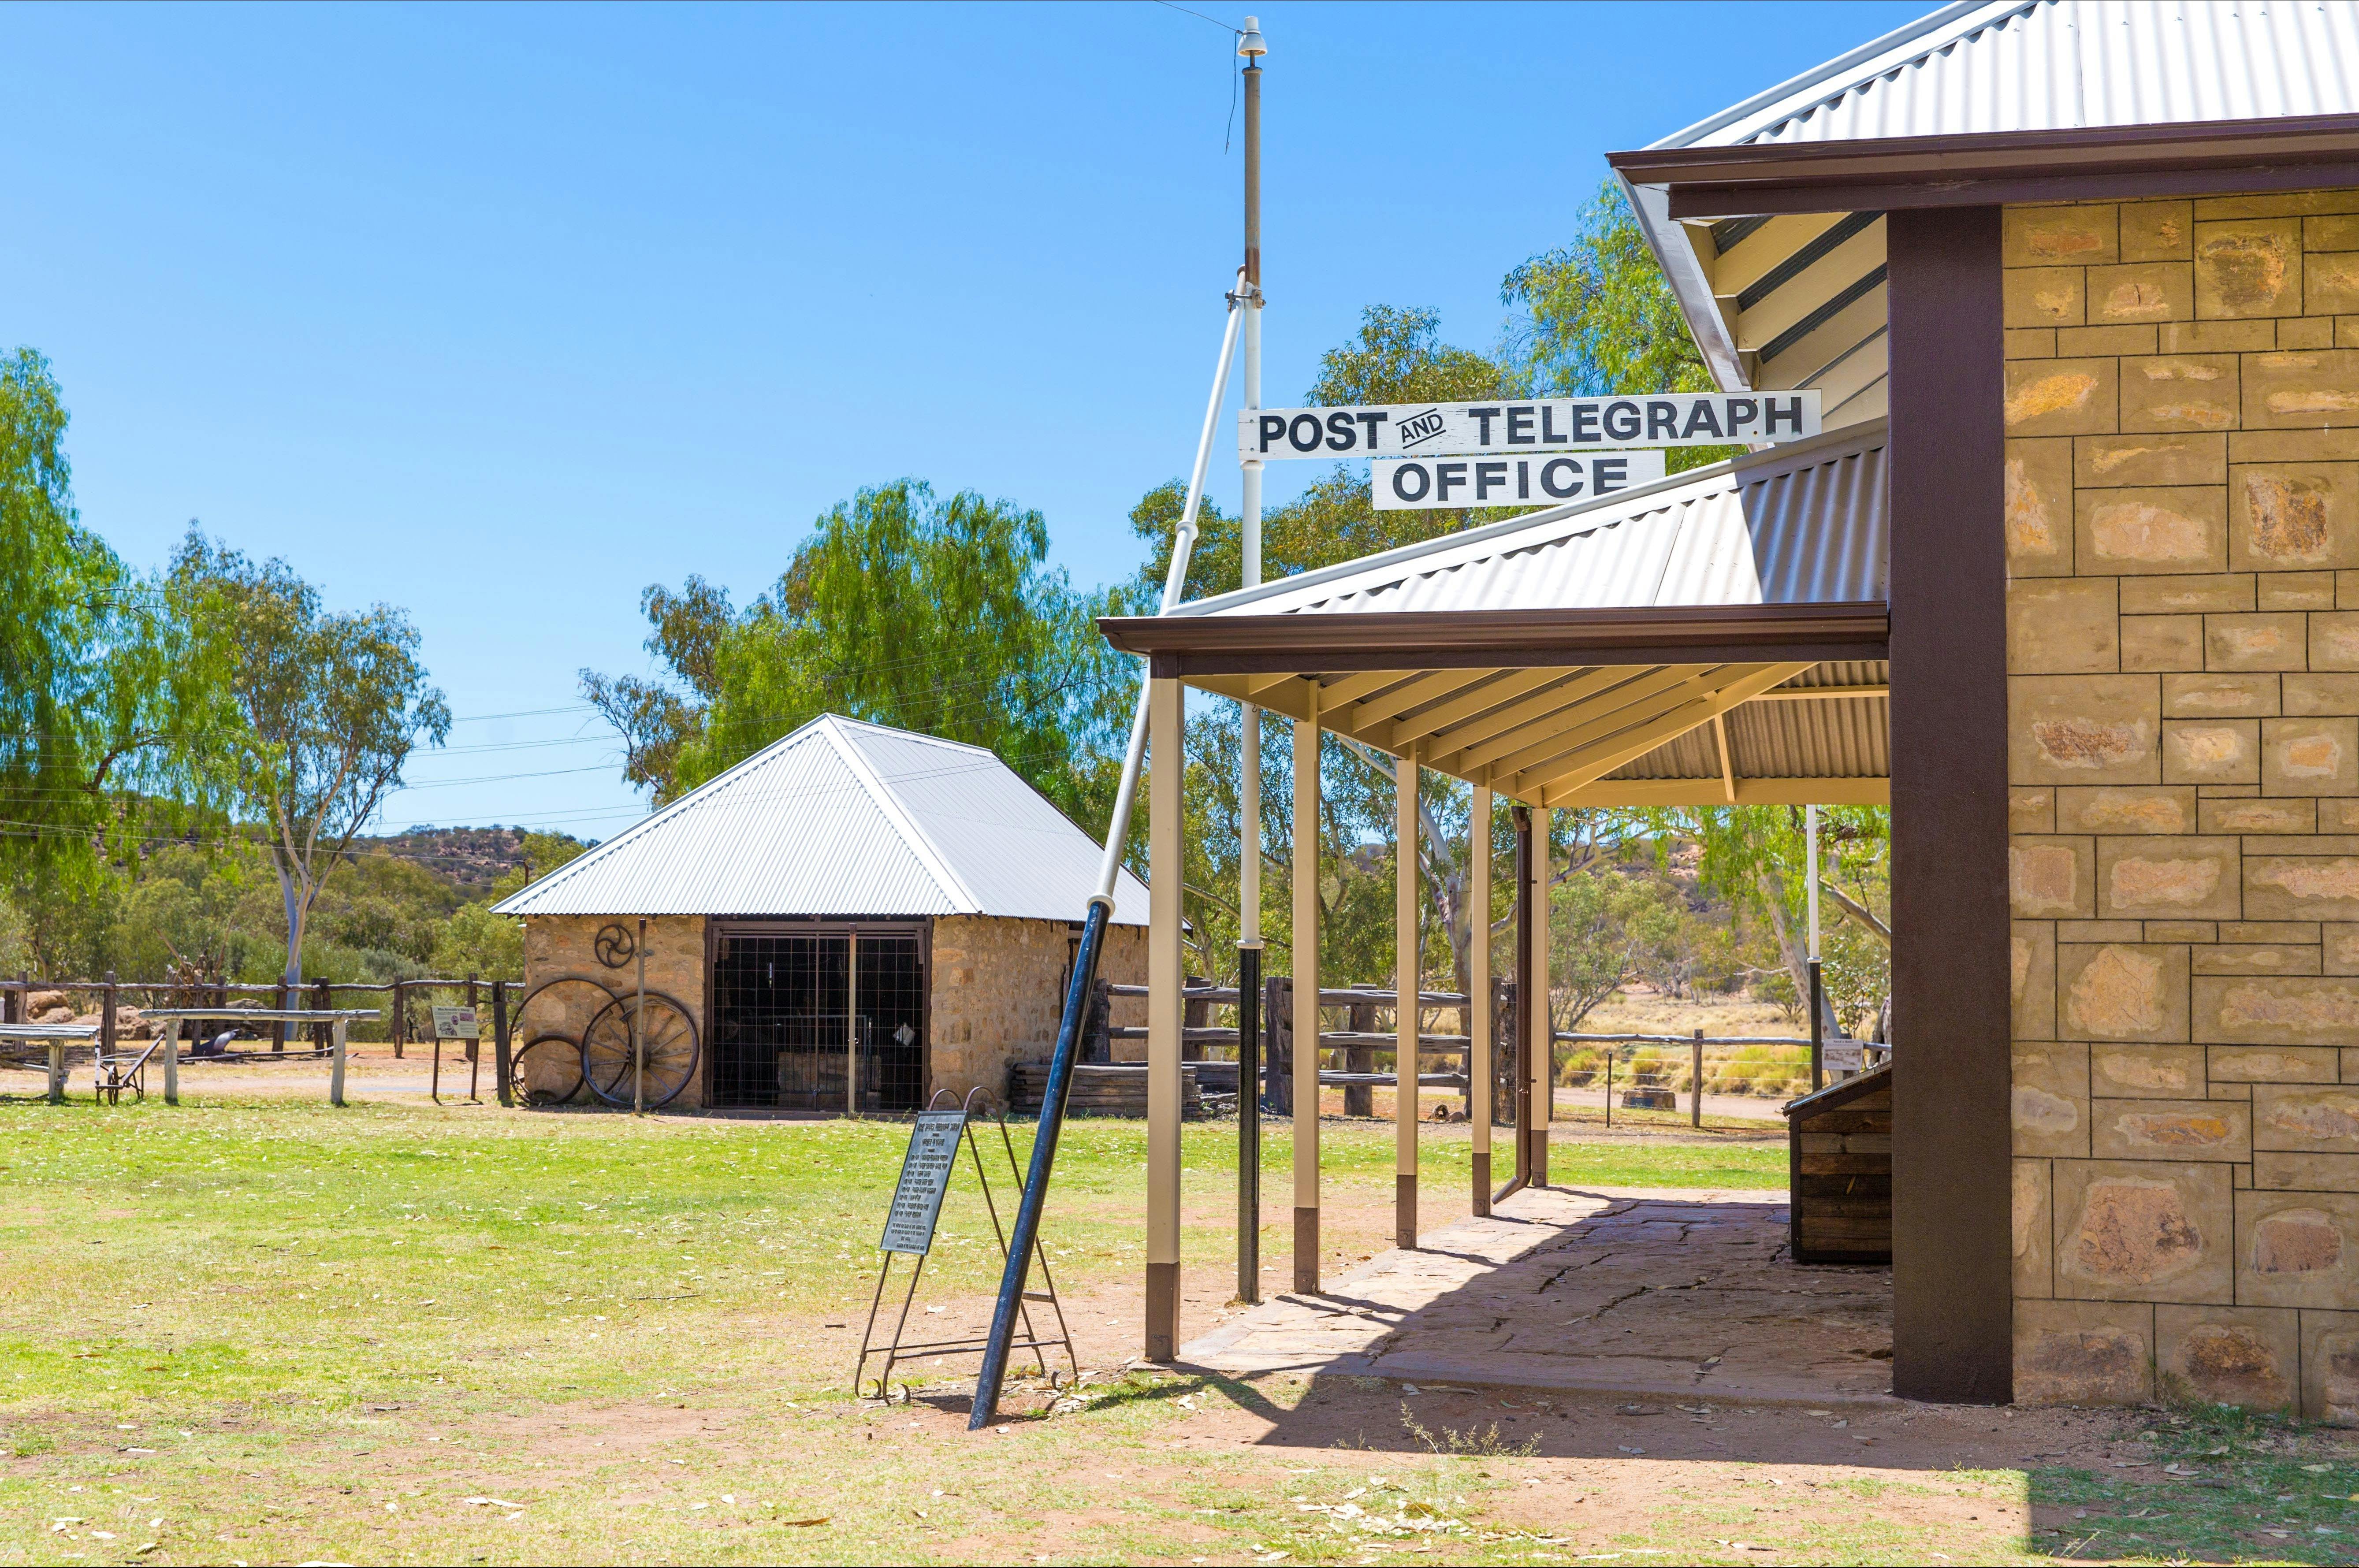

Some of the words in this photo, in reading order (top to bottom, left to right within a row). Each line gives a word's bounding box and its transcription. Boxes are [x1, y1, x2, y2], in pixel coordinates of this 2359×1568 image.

[1259, 412, 1388, 453] POST
[1401, 414, 1444, 444] AND
[1468, 397, 1802, 446] TELEGRAPH
[1393, 458, 1628, 502] OFFICE
